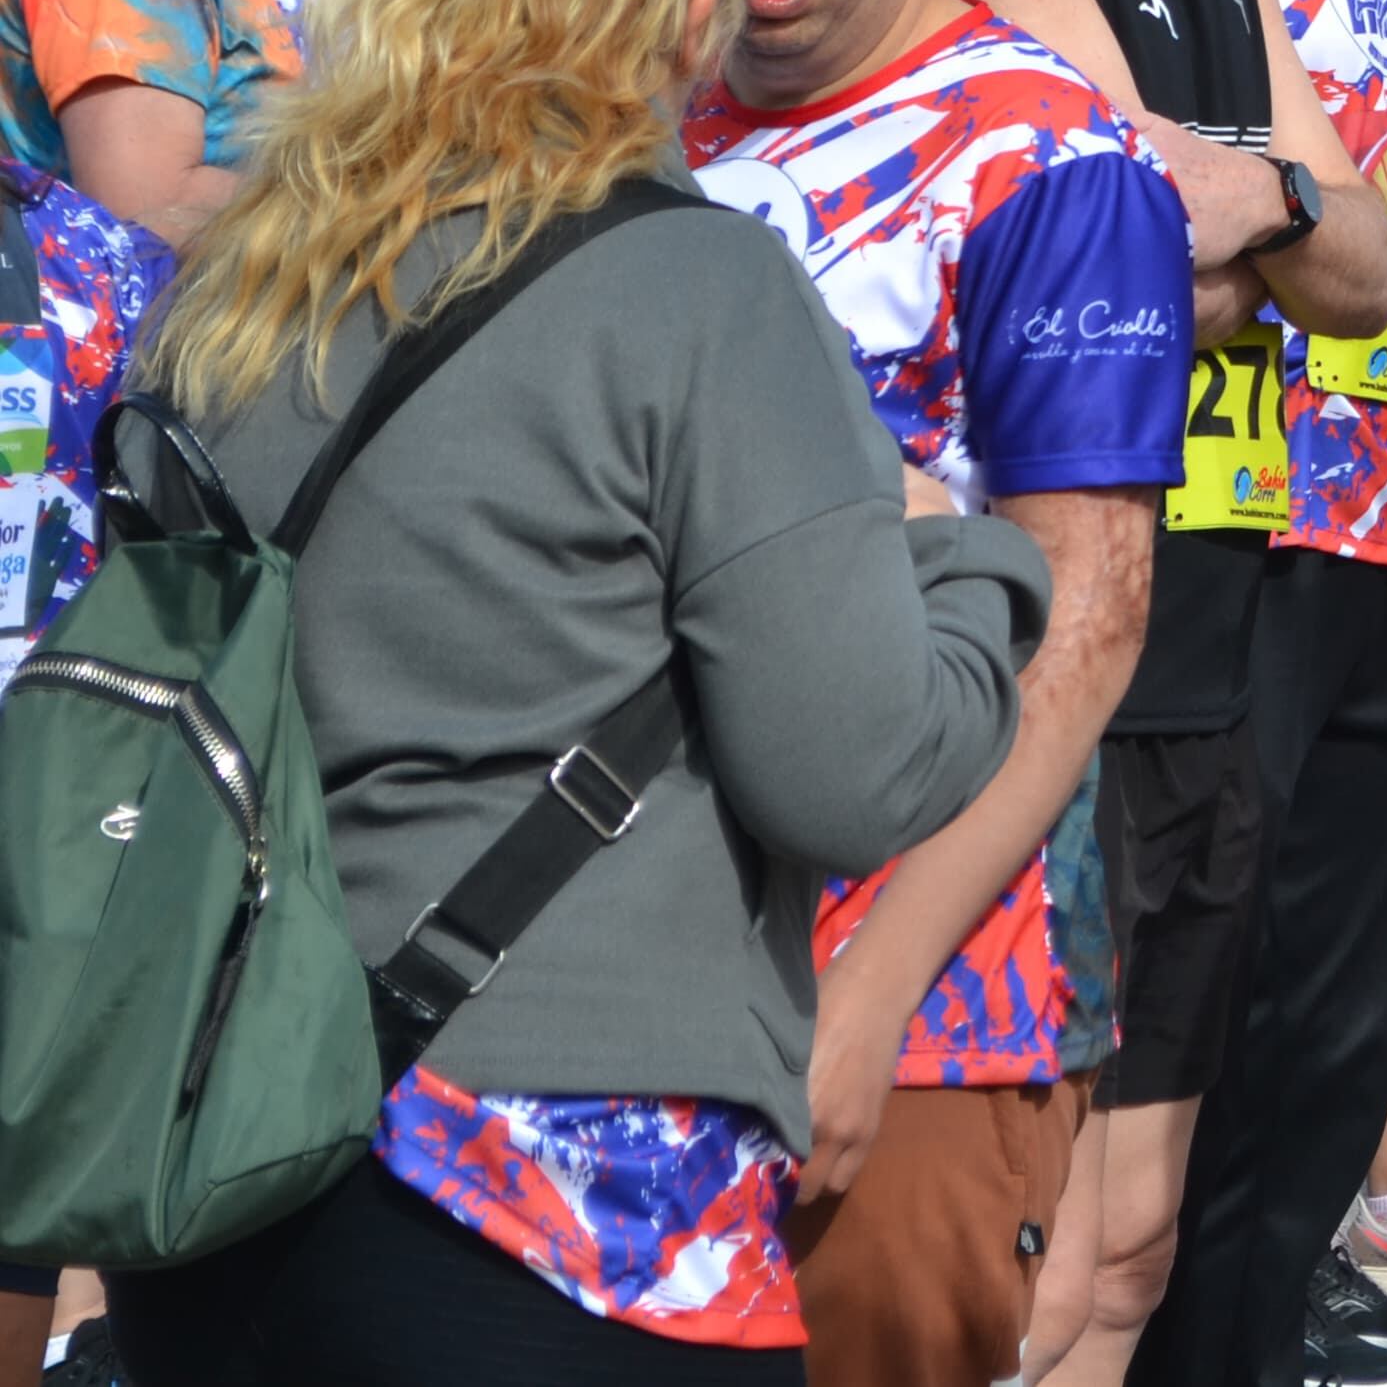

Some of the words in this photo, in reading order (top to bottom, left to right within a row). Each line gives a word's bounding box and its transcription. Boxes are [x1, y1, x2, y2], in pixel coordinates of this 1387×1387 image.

[1022, 306, 1067, 344] El
[1078, 300, 1168, 340] Criollo
[1187, 345, 1286, 441] 27
